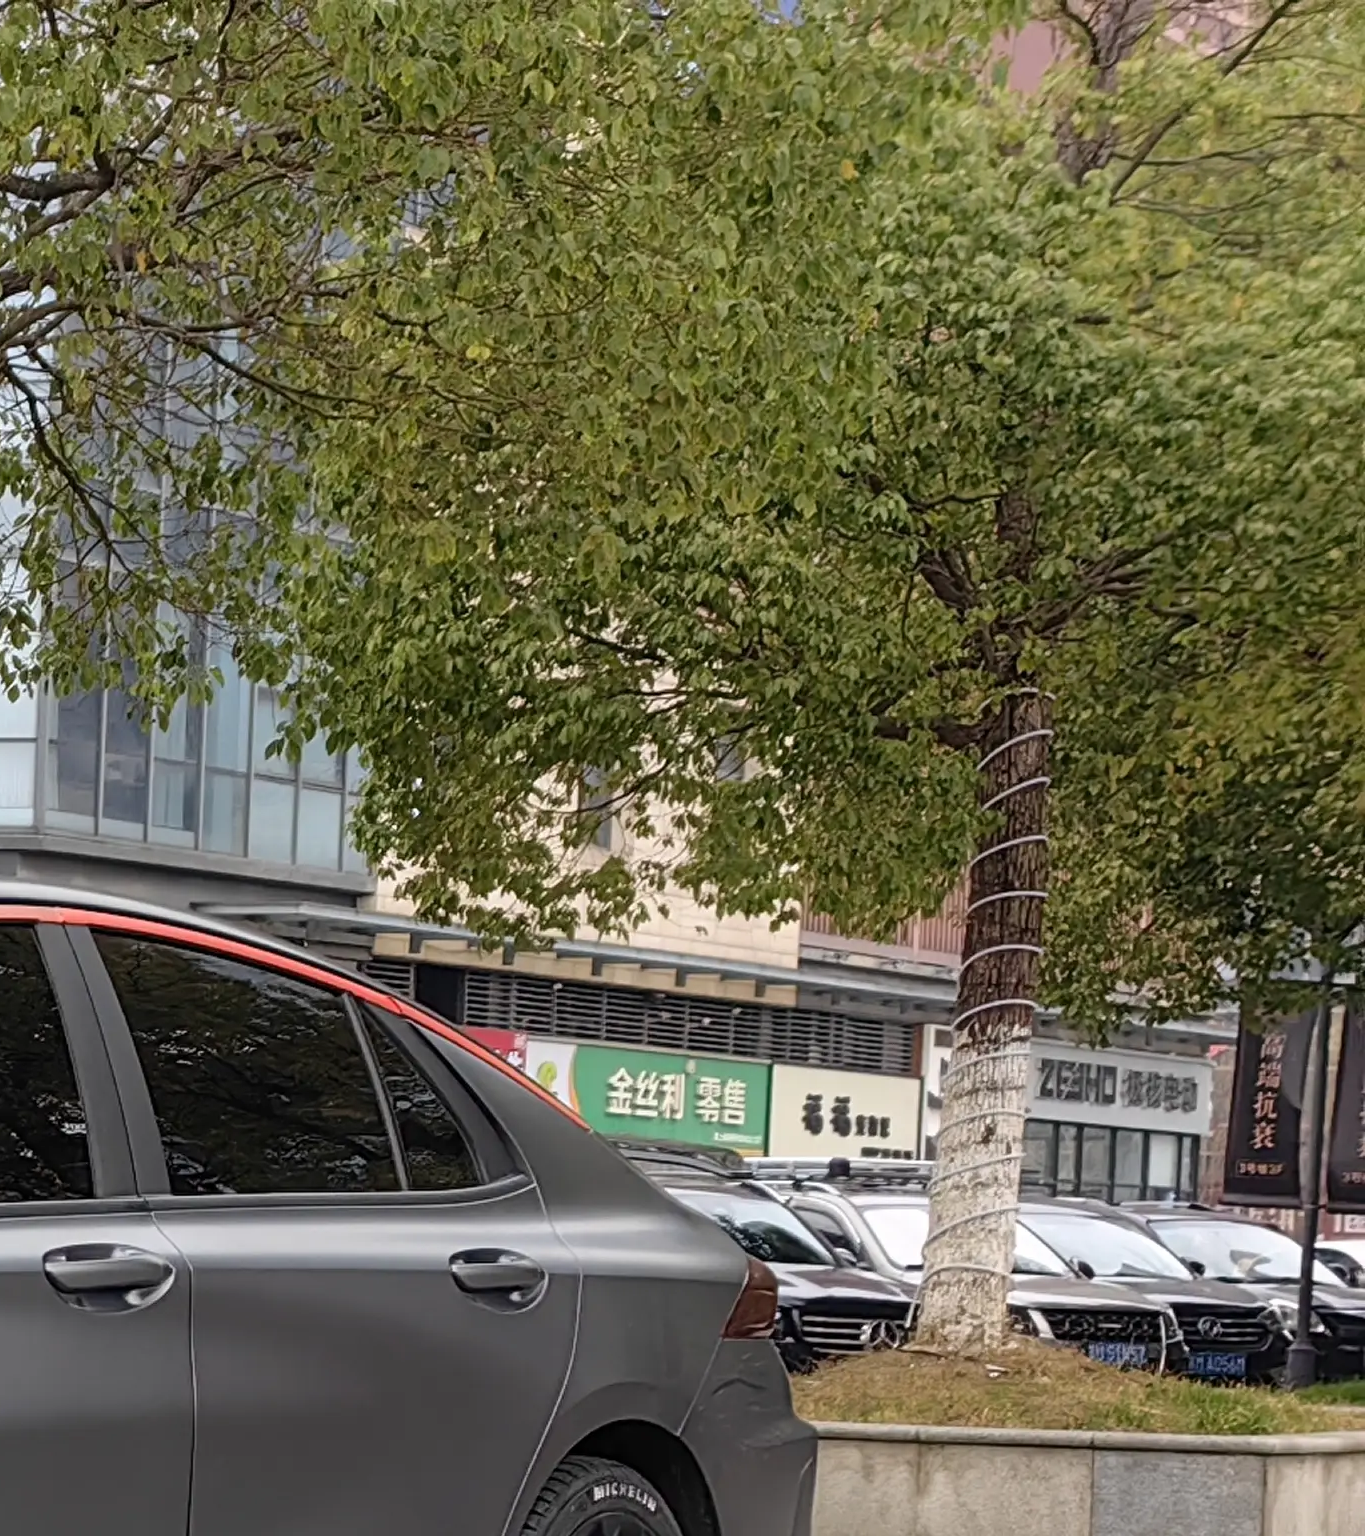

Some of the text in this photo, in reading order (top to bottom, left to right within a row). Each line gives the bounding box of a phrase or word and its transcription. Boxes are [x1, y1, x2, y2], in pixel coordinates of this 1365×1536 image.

[604, 1067, 686, 1120] 金丝利
[695, 1076, 747, 1126] 零售
[593, 1482, 657, 1513] MICHELIN
